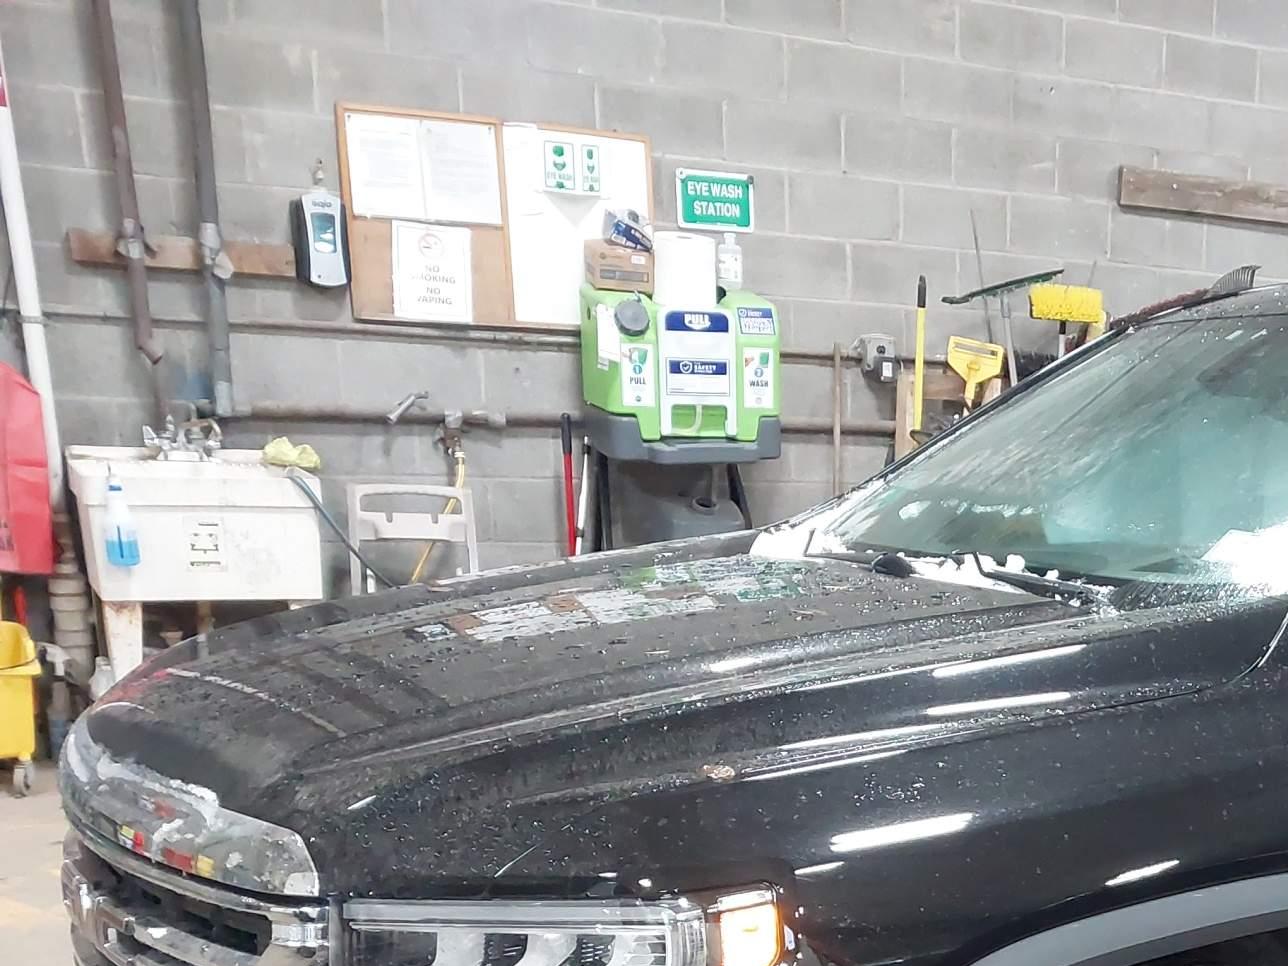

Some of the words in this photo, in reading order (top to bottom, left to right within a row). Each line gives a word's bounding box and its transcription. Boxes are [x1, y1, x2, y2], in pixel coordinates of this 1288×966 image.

[687, 181, 709, 196] EYE
[710, 182, 743, 199] WASH
[693, 200, 740, 217] STATION
[424, 265, 440, 273] NO
[426, 287, 441, 295] NO
[417, 295, 453, 305] VAPING
[629, 376, 647, 385] PULL
[749, 380, 769, 388] WASH
